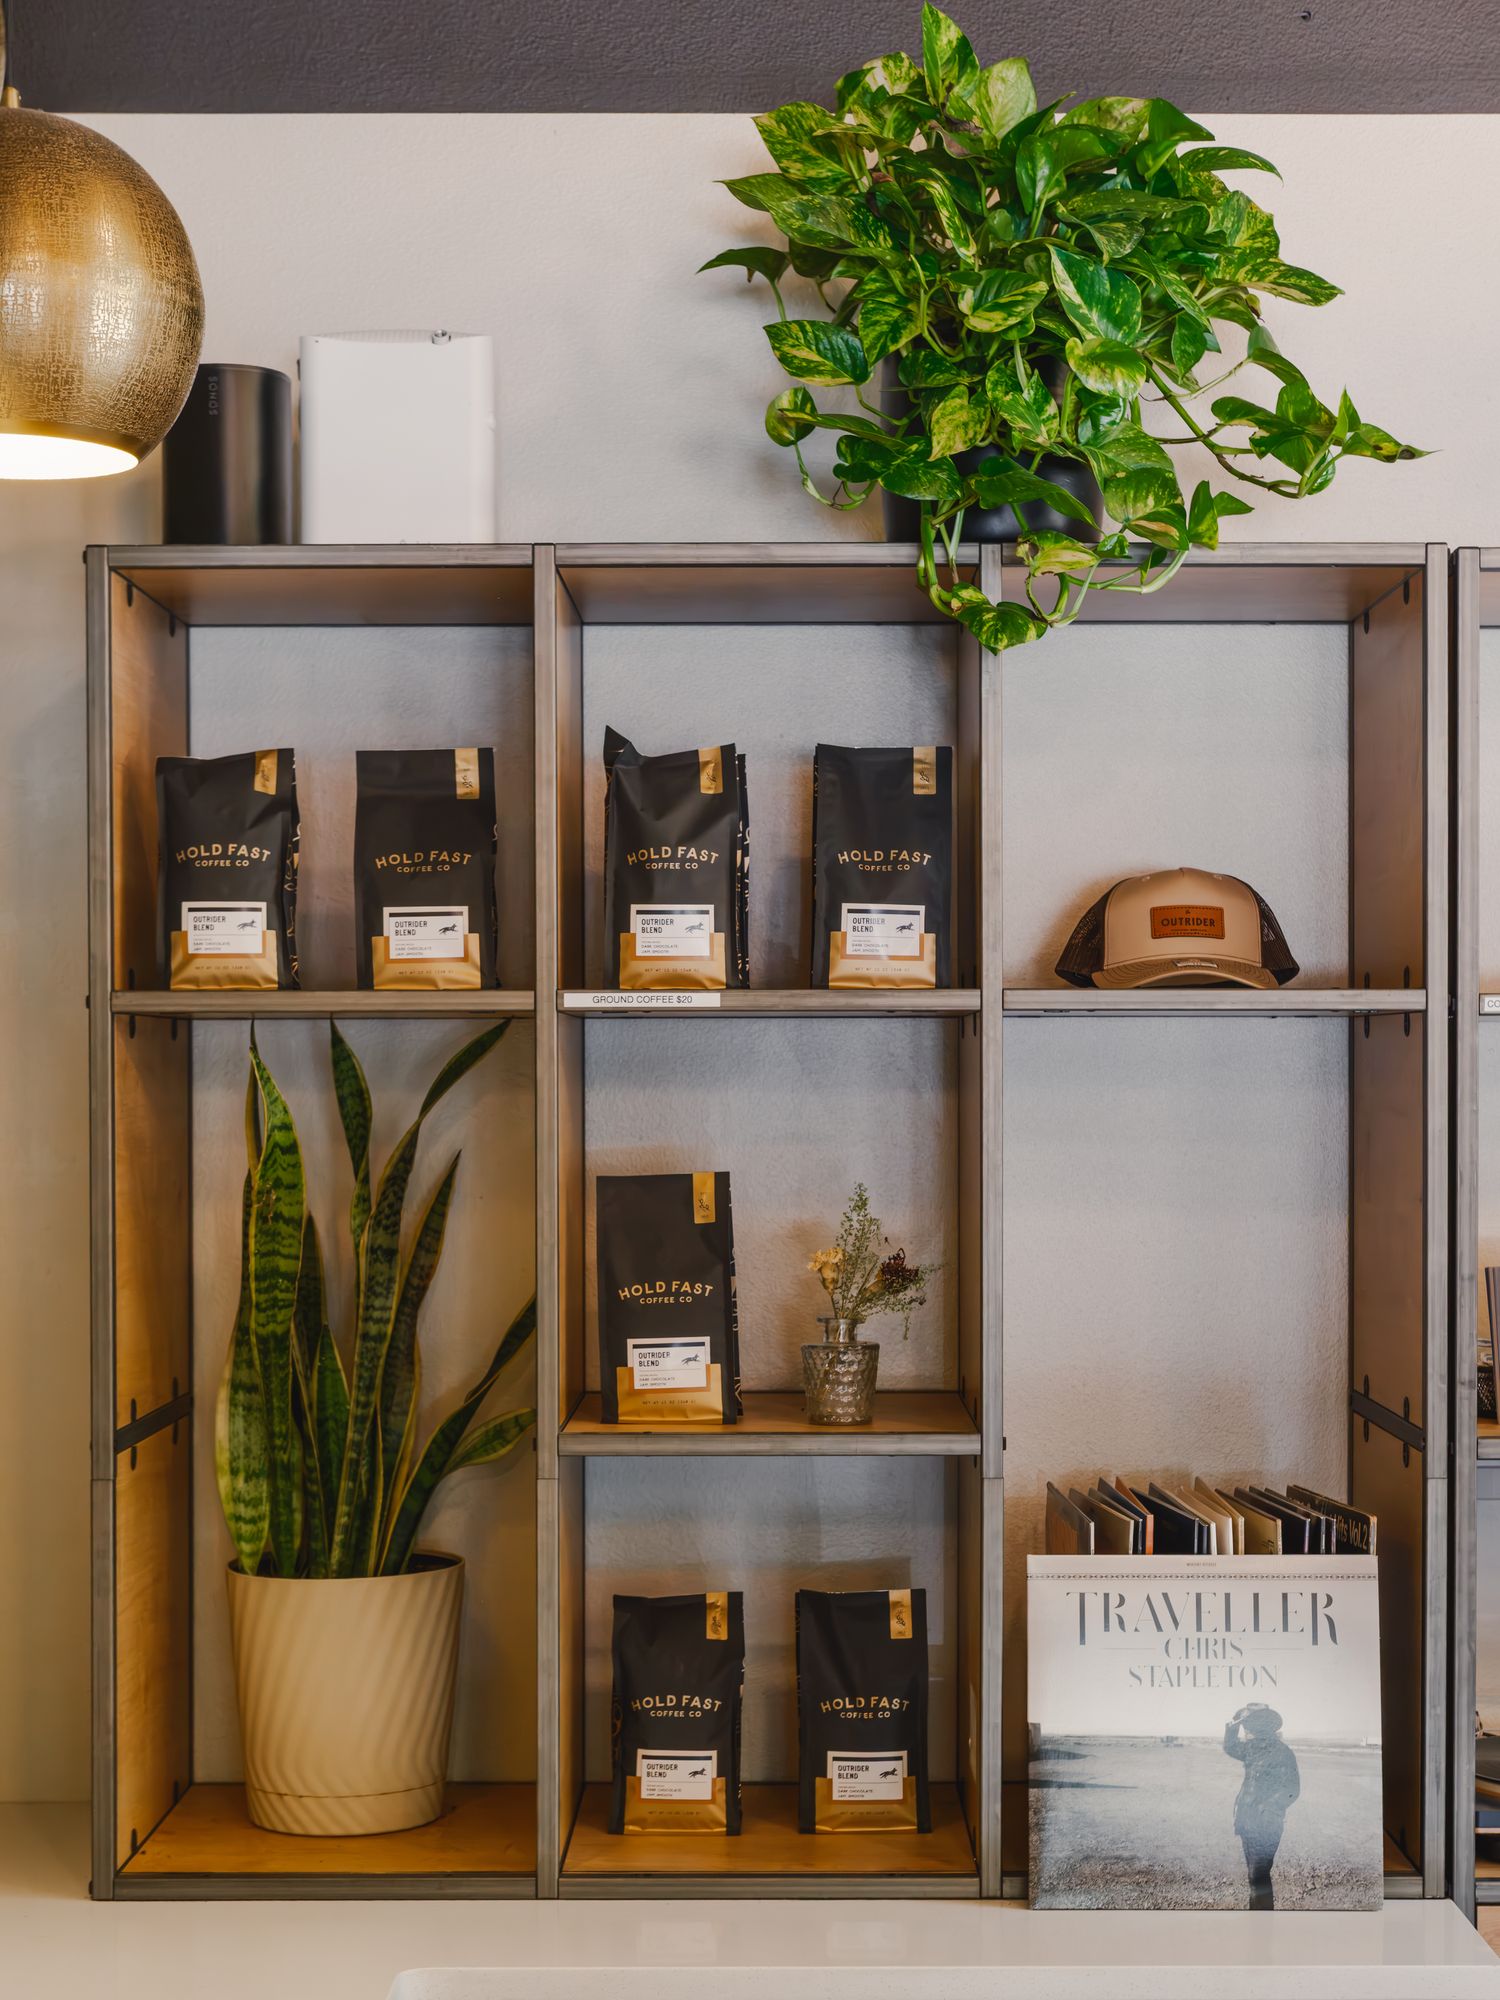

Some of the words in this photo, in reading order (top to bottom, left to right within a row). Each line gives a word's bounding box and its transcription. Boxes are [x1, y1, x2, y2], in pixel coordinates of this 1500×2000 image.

[208, 376, 218, 416] SONOS
[175, 843, 223, 863] HOLD
[228, 843, 271, 862] FAST
[626, 846, 673, 866] HOLD
[677, 846, 720, 865] FAST
[375, 851, 424, 870] HOLD
[430, 851, 472, 867] FAST
[837, 849, 885, 865] HOLD
[889, 849, 932, 867] FAST
[194, 859, 231, 868] COFFEE
[235, 859, 250, 867] CO
[644, 862, 682, 870] COFFEE
[684, 862, 699, 870] CO
[858, 863, 893, 872] COFFEE
[897, 863, 911, 871] CO
[396, 864, 433, 873] COFFEE
[436, 864, 451, 872] CO
[193, 915, 226, 923] OUTRIDER
[641, 918, 675, 926] OUTRIDER
[852, 917, 886, 925] OUTRIDER
[1160, 916, 1216, 929] OUTRIDER
[394, 920, 428, 928] OUTRIDER
[394, 929, 417, 937] BLEND
[641, 926, 663, 934] BLEND
[852, 925, 874, 933] BLEND
[592, 995, 634, 1004] GROUND
[636, 995, 674, 1004] COFFEE
[676, 994, 693, 1004] $20
[618, 1281, 667, 1300] HOLD
[671, 1280, 714, 1298] FAST
[639, 1296, 675, 1305] COFFEE
[679, 1295, 693, 1303] CO
[638, 1351, 671, 1360] OUTRIDER
[638, 1359, 660, 1368] BLEND
[1066, 1592, 1338, 1646] TRAVELLER
[1164, 1637, 1244, 1660] CHRIS
[1129, 1664, 1279, 1688] STAPLETON
[631, 1694, 677, 1712] HOLD
[681, 1694, 723, 1713] FAST
[820, 1696, 866, 1713] HOLD
[870, 1696, 910, 1712] FAST
[649, 1710, 686, 1718] COFFEE
[688, 1710, 702, 1718] CO
[839, 1711, 875, 1719] COFFEE
[877, 1711, 891, 1719] CO
[646, 1763, 679, 1771] OUTRIDER
[646, 1771, 667, 1779] BLEND
[837, 1772, 859, 1780] BLEND
